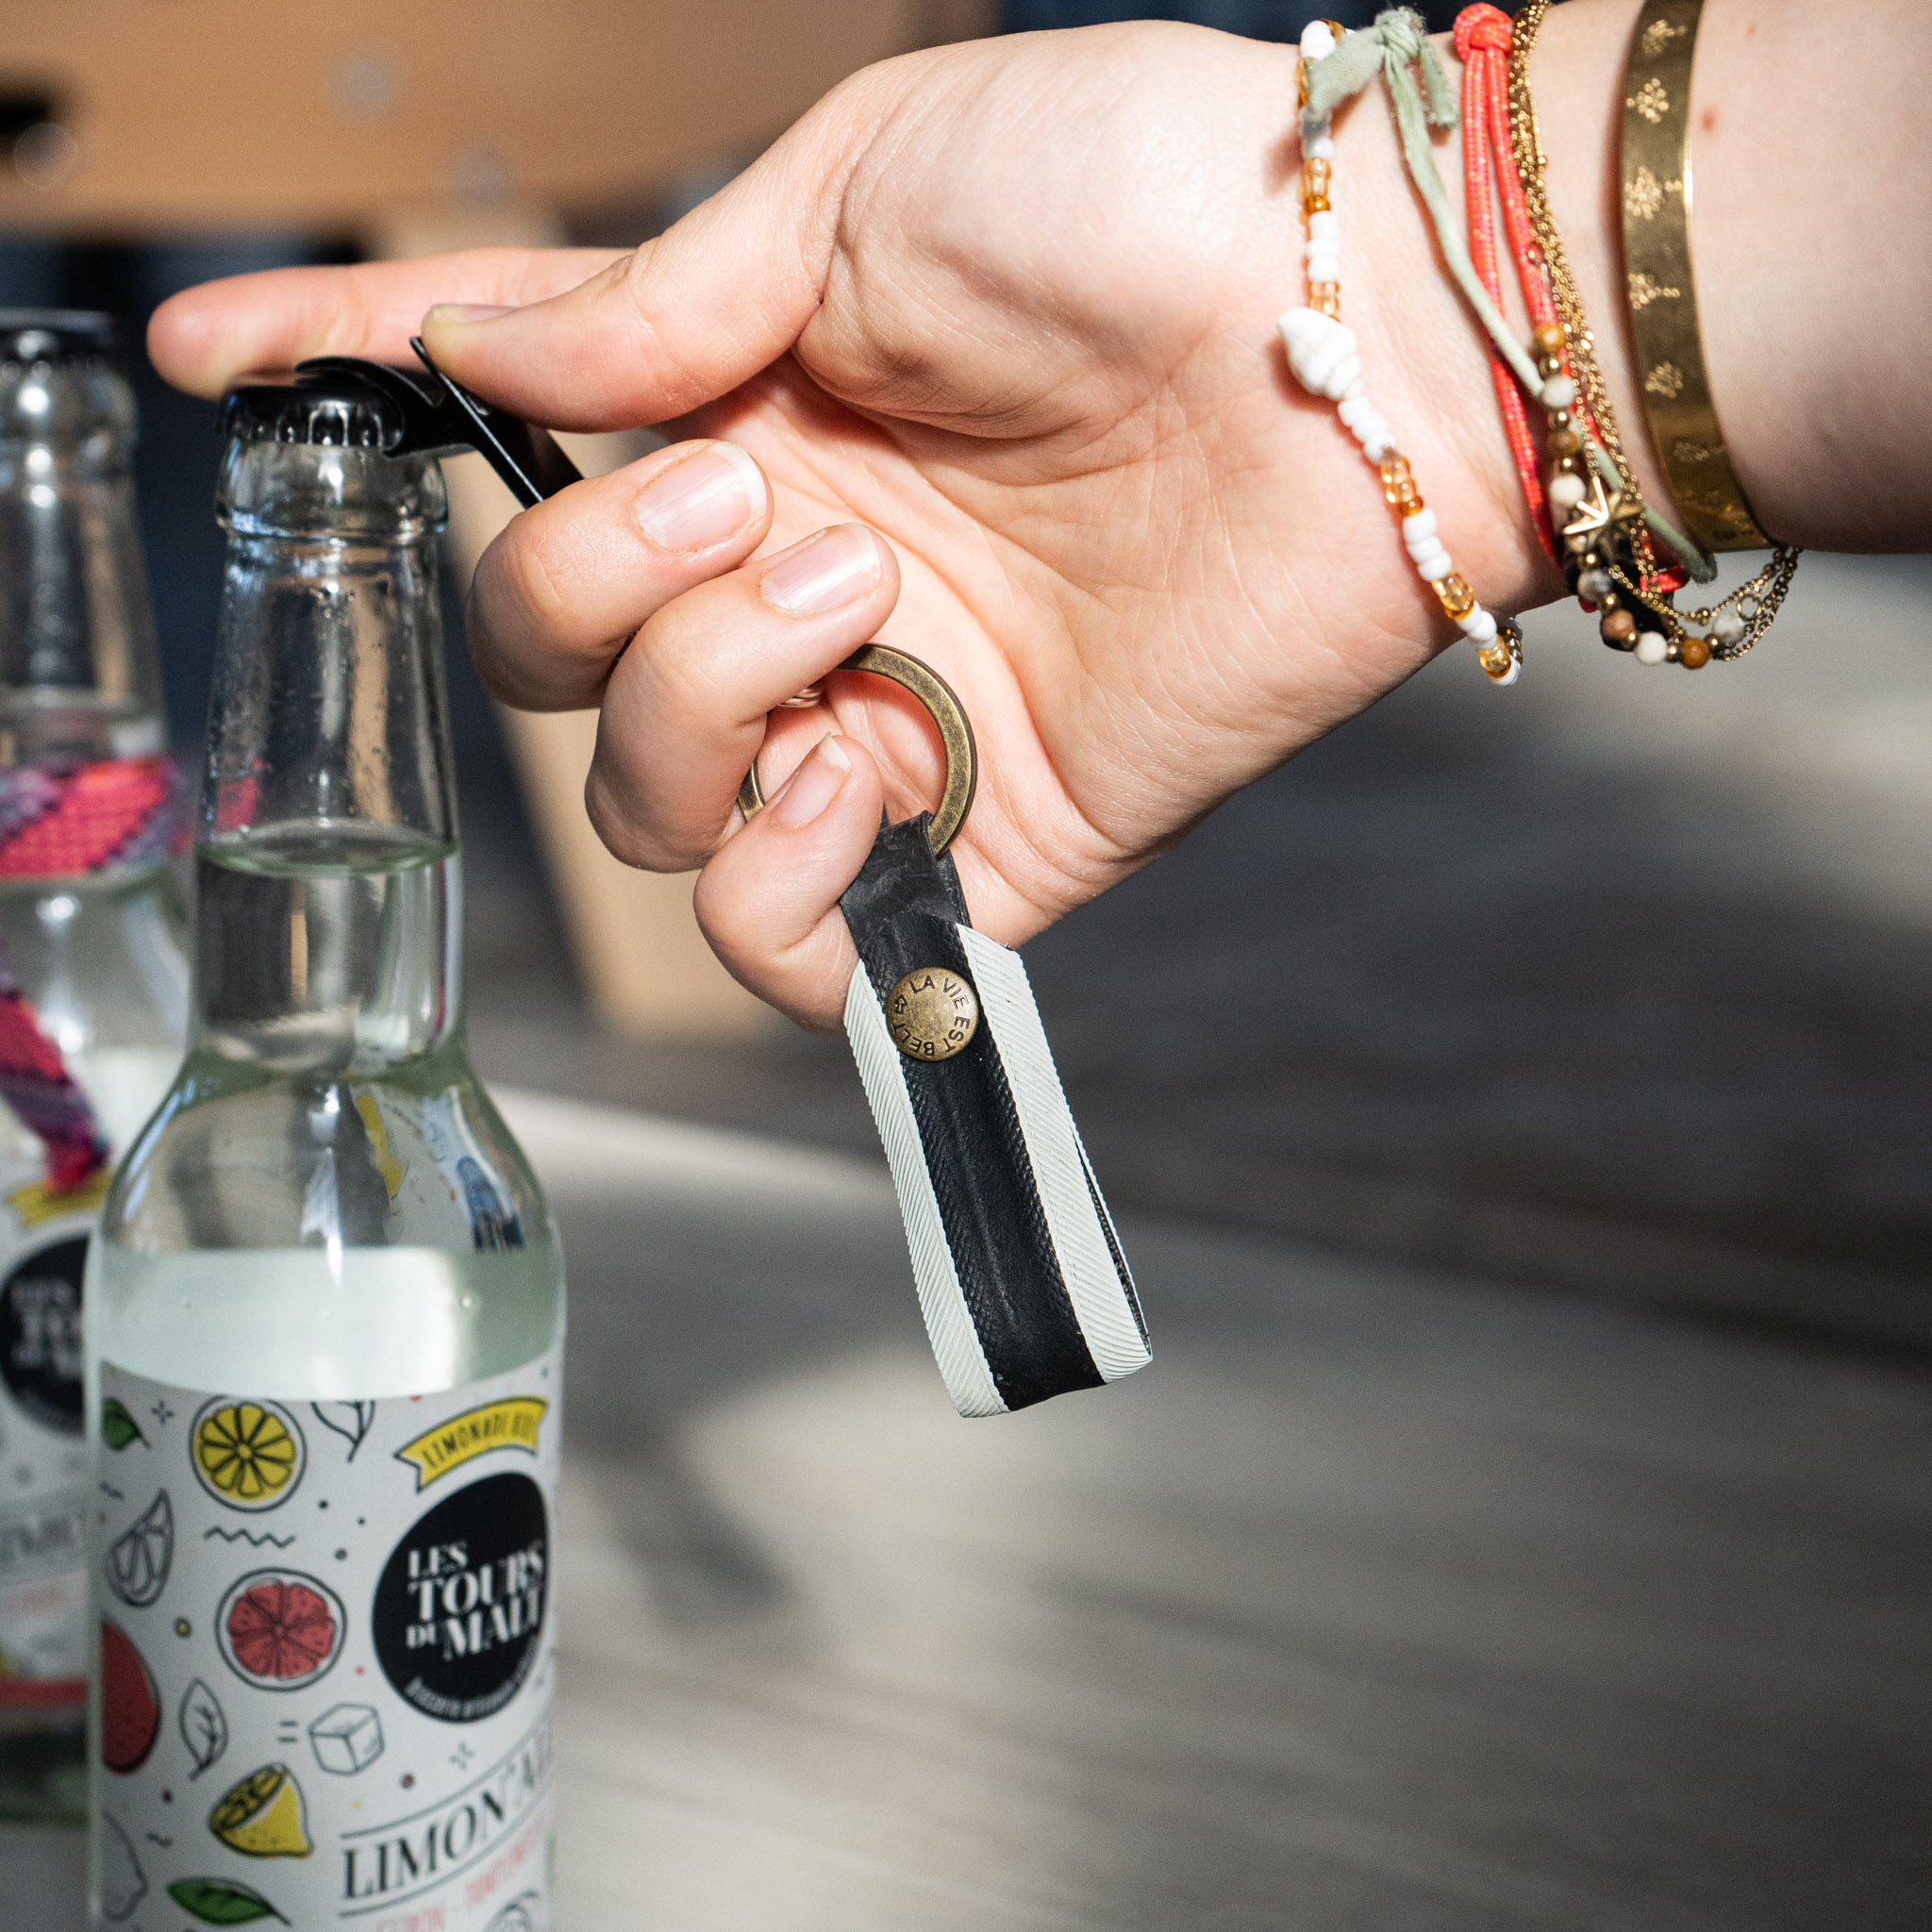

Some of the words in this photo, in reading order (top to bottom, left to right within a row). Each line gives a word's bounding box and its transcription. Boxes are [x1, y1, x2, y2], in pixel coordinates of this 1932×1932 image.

[909, 974, 936, 994] LA
[942, 977, 971, 1010] VIE
[891, 1023, 936, 1057] BELT
[942, 1015, 971, 1053] EST
[408, 1540, 469, 1579] LES
[408, 1540, 543, 1623] TOURS
